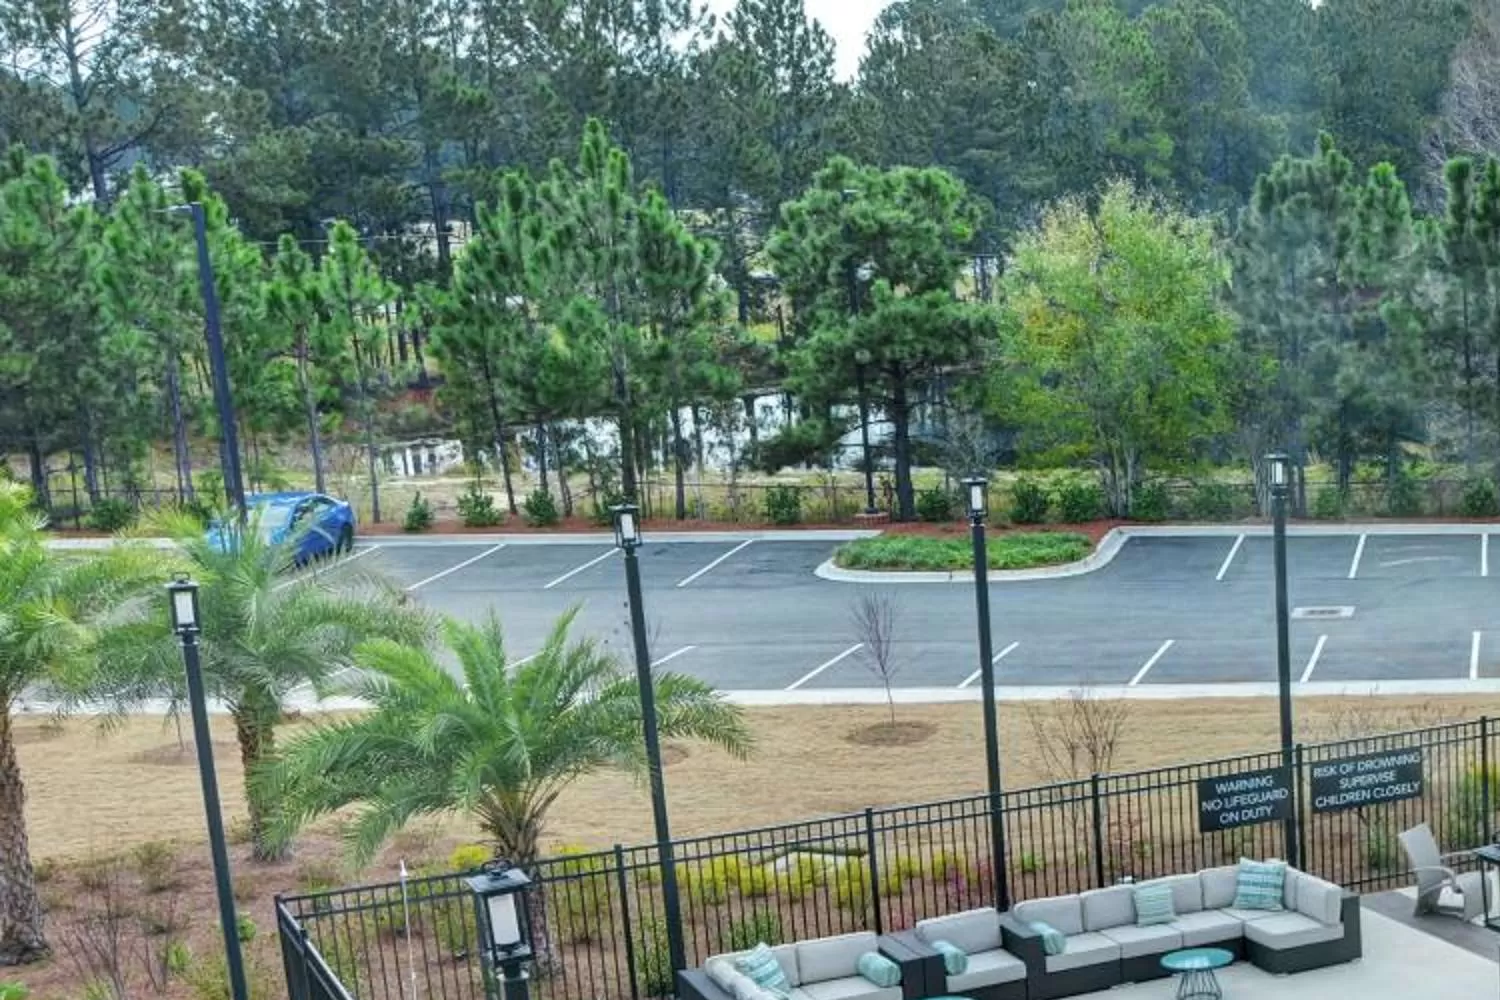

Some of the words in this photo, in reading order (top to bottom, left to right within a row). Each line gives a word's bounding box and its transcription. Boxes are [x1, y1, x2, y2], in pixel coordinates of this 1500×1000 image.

[1313, 765, 1337, 778] RISK
[1339, 763, 1356, 775] OF
[1357, 753, 1420, 772] DROWNING
[1215, 775, 1274, 795] WARNING
[1339, 770, 1397, 789] SUPERVISE
[1201, 798, 1223, 812] NO
[1224, 787, 1289, 809] LIFEGUARD
[1315, 789, 1371, 808] CHILDREN
[1373, 780, 1420, 799] CLOSELY
[1219, 811, 1240, 825] ON
[1241, 805, 1273, 821] DUTY
